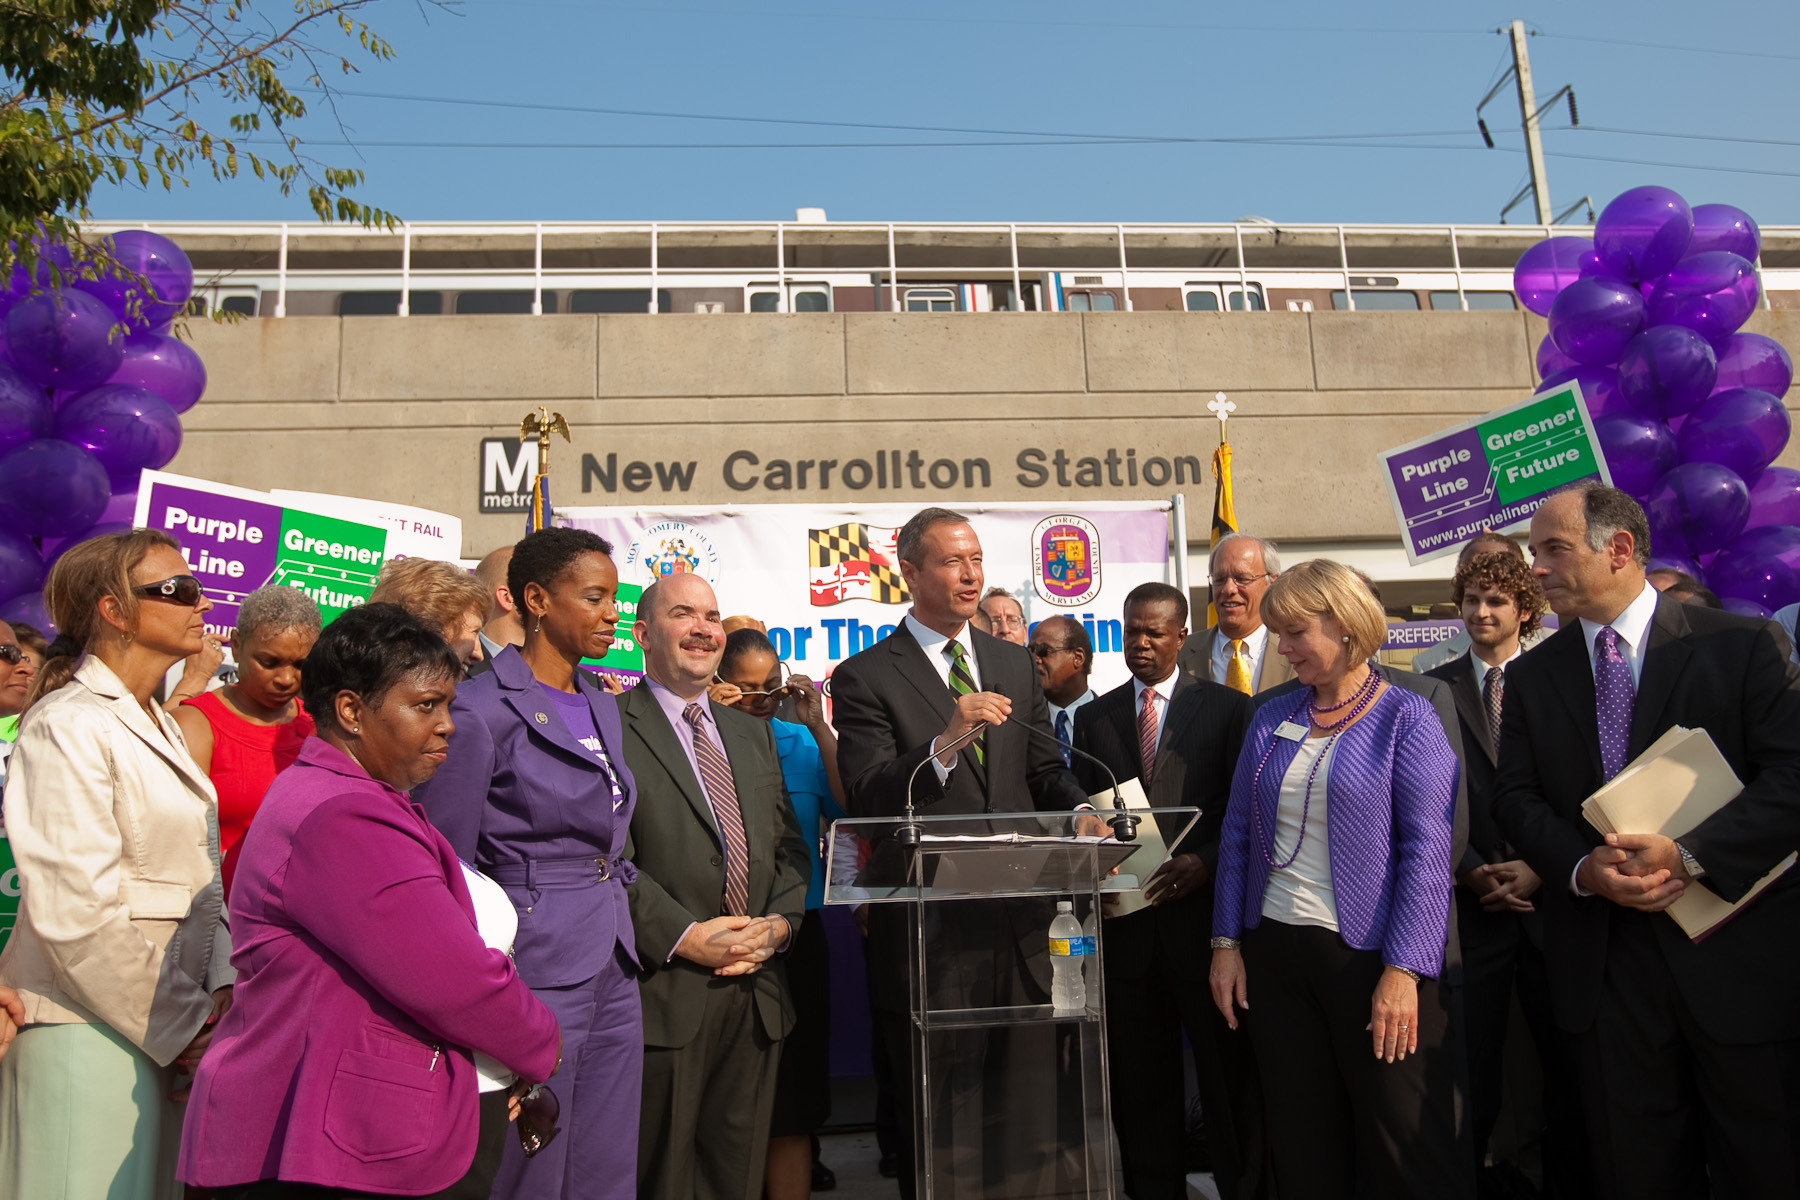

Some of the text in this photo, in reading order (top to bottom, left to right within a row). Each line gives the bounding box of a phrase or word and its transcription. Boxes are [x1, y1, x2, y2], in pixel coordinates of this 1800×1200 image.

[1486, 407, 1577, 452] Greener
[484, 441, 539, 493] M
[581, 448, 1202, 493] New Carrollton Station
[1401, 448, 1472, 483] Purple
[1505, 447, 1580, 484] Future
[1421, 476, 1469, 503] Line
[164, 505, 264, 545] Purple
[413, 521, 444, 539] RAIL
[1418, 496, 1550, 550] www.purplelinen
[181, 546, 246, 578] Line
[283, 528, 382, 566] Greener
[764, 625, 813, 662] or
